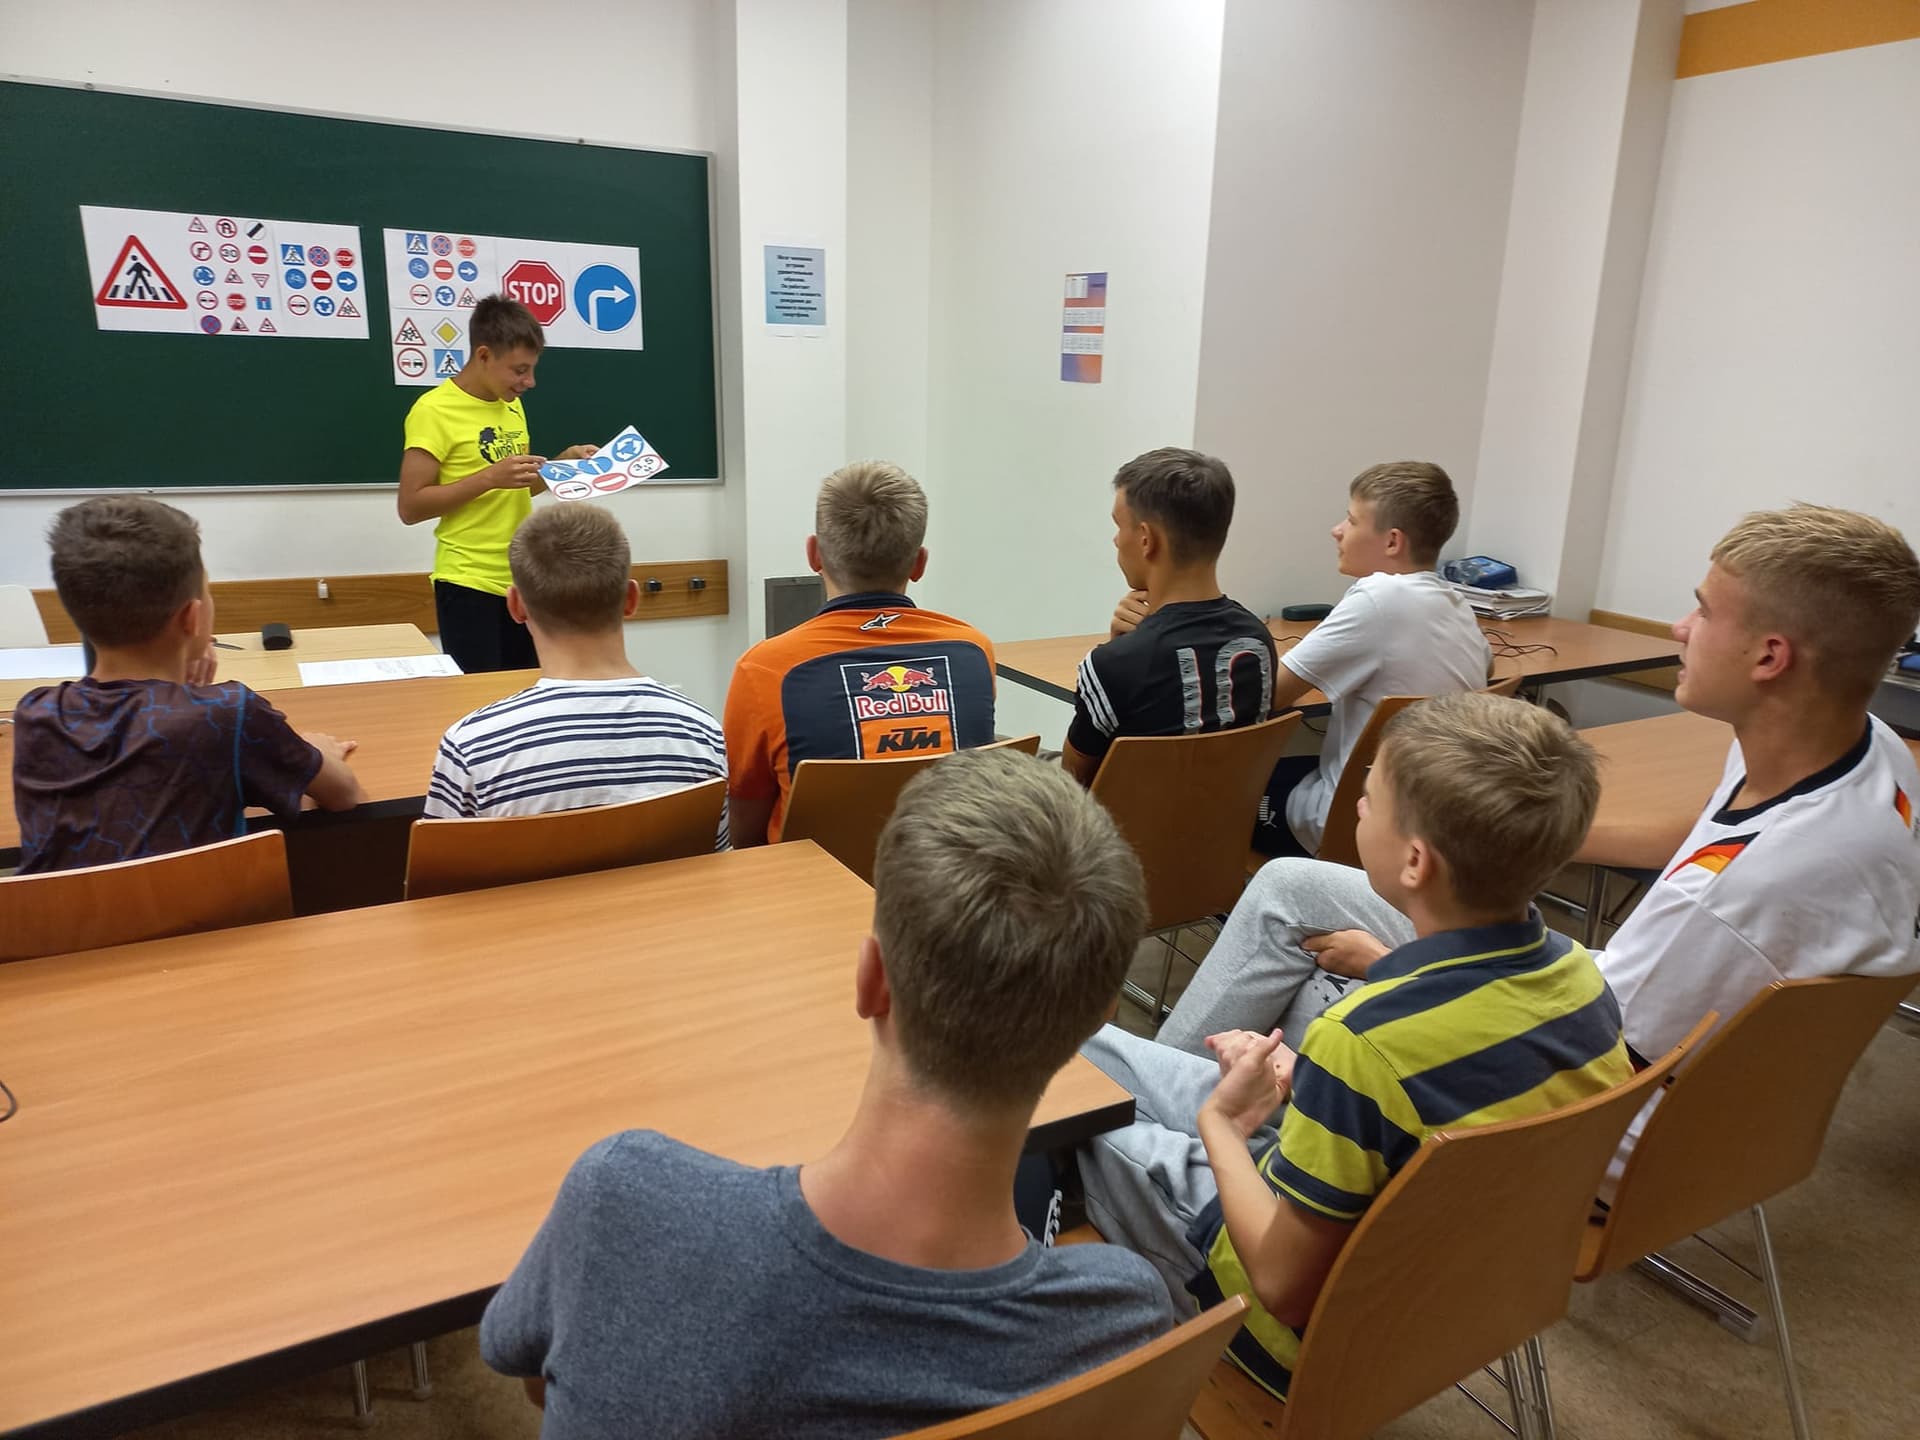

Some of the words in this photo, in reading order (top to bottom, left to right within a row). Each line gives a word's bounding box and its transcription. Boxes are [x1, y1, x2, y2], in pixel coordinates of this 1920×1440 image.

[508, 280, 559, 305] STOP
[1176, 637, 1272, 735] 10
[855, 693, 904, 719] Red
[904, 689, 949, 713] Bull
[876, 726, 941, 753] KTM
